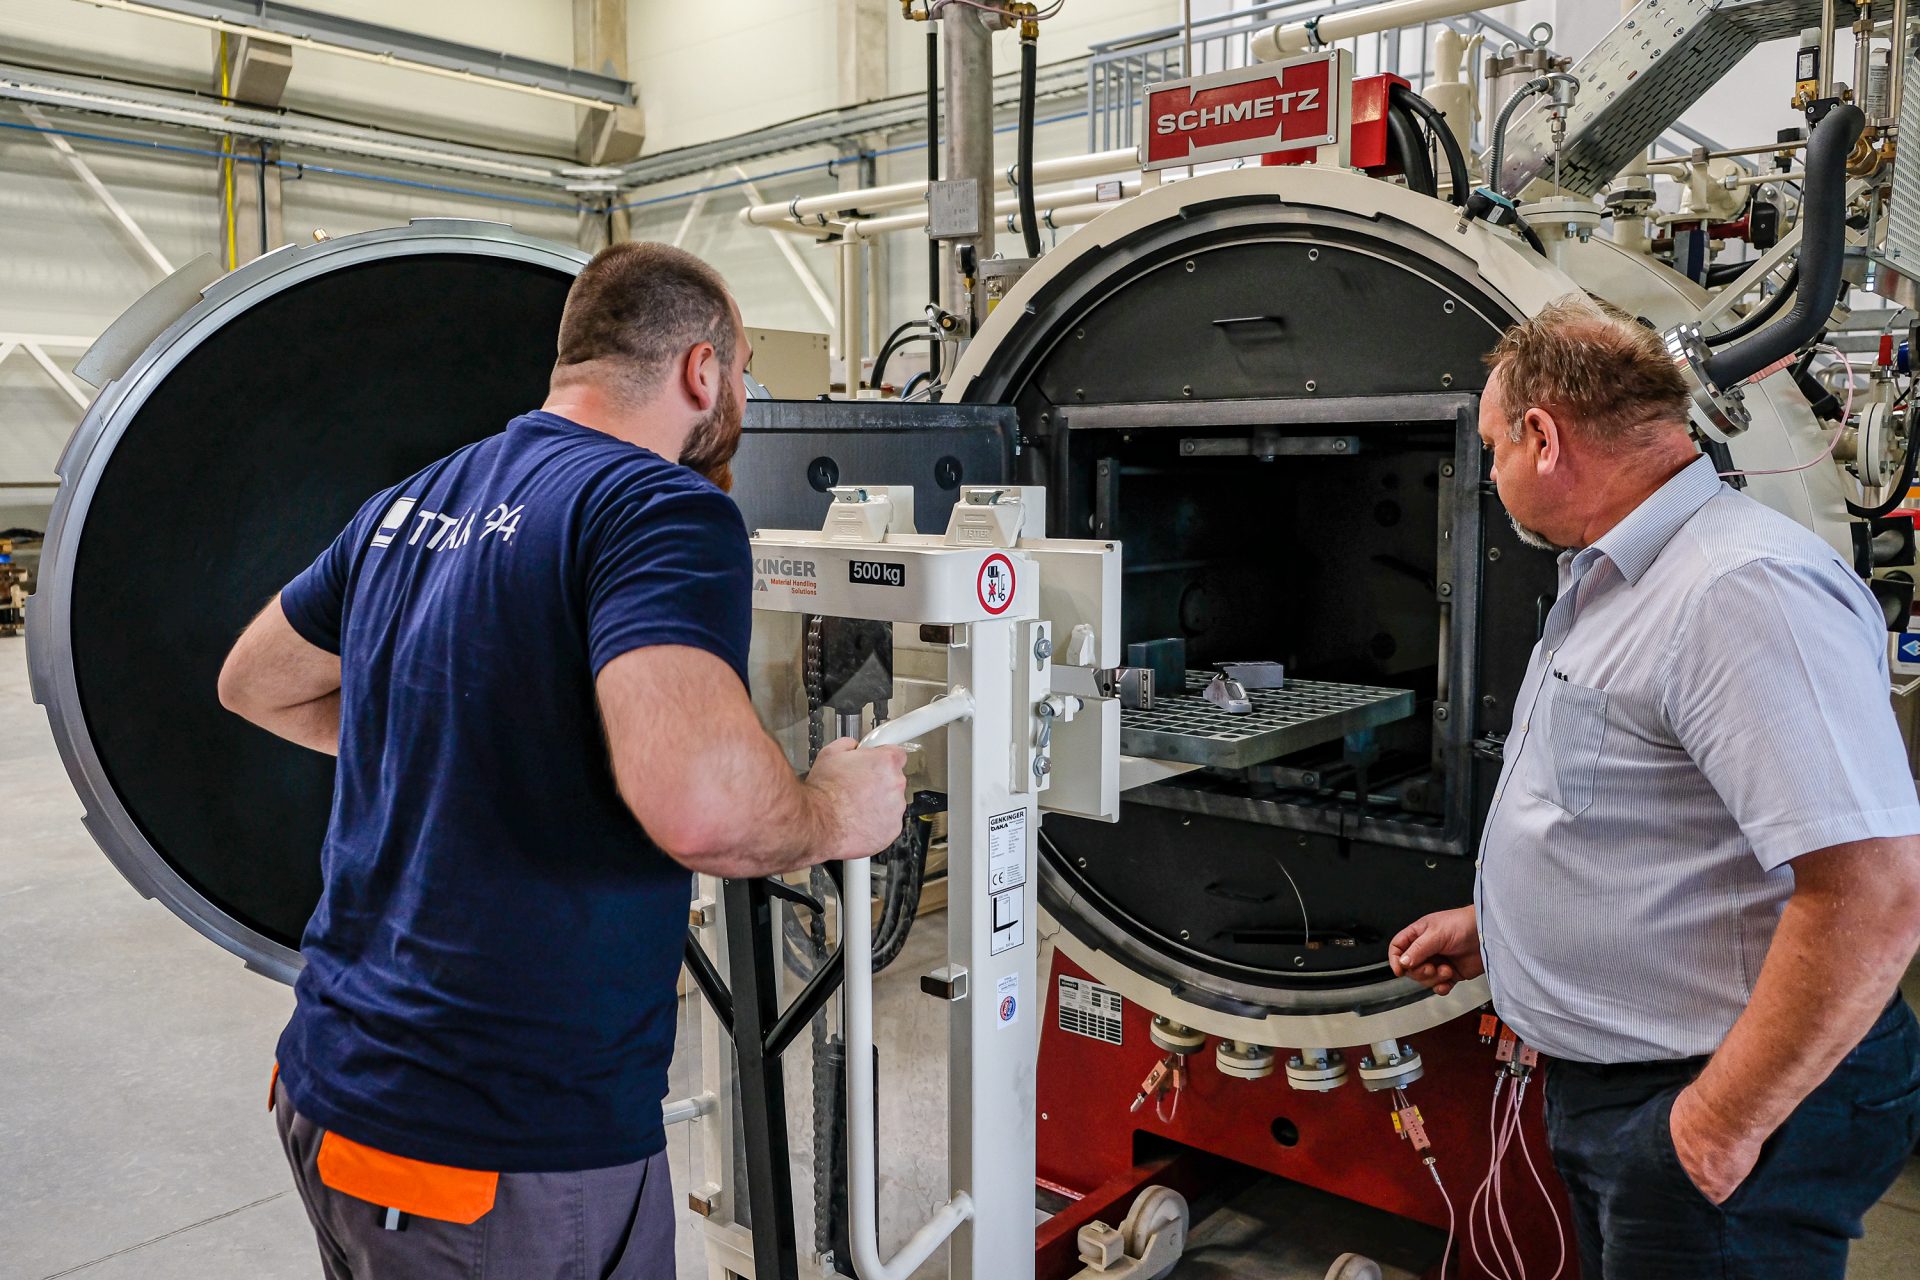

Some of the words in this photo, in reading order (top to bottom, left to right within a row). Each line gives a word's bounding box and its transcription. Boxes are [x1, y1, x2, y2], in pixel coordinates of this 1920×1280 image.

[1156, 88, 1320, 135] SCHMETZ
[752, 558, 816, 578] KINGER
[853, 562, 881, 580] 500
[883, 564, 900, 585] kg
[771, 579, 792, 587] Material
[793, 580, 816, 589] Handling
[791, 587, 817, 596] Solutions
[990, 811, 1024, 826] GENKINGER
